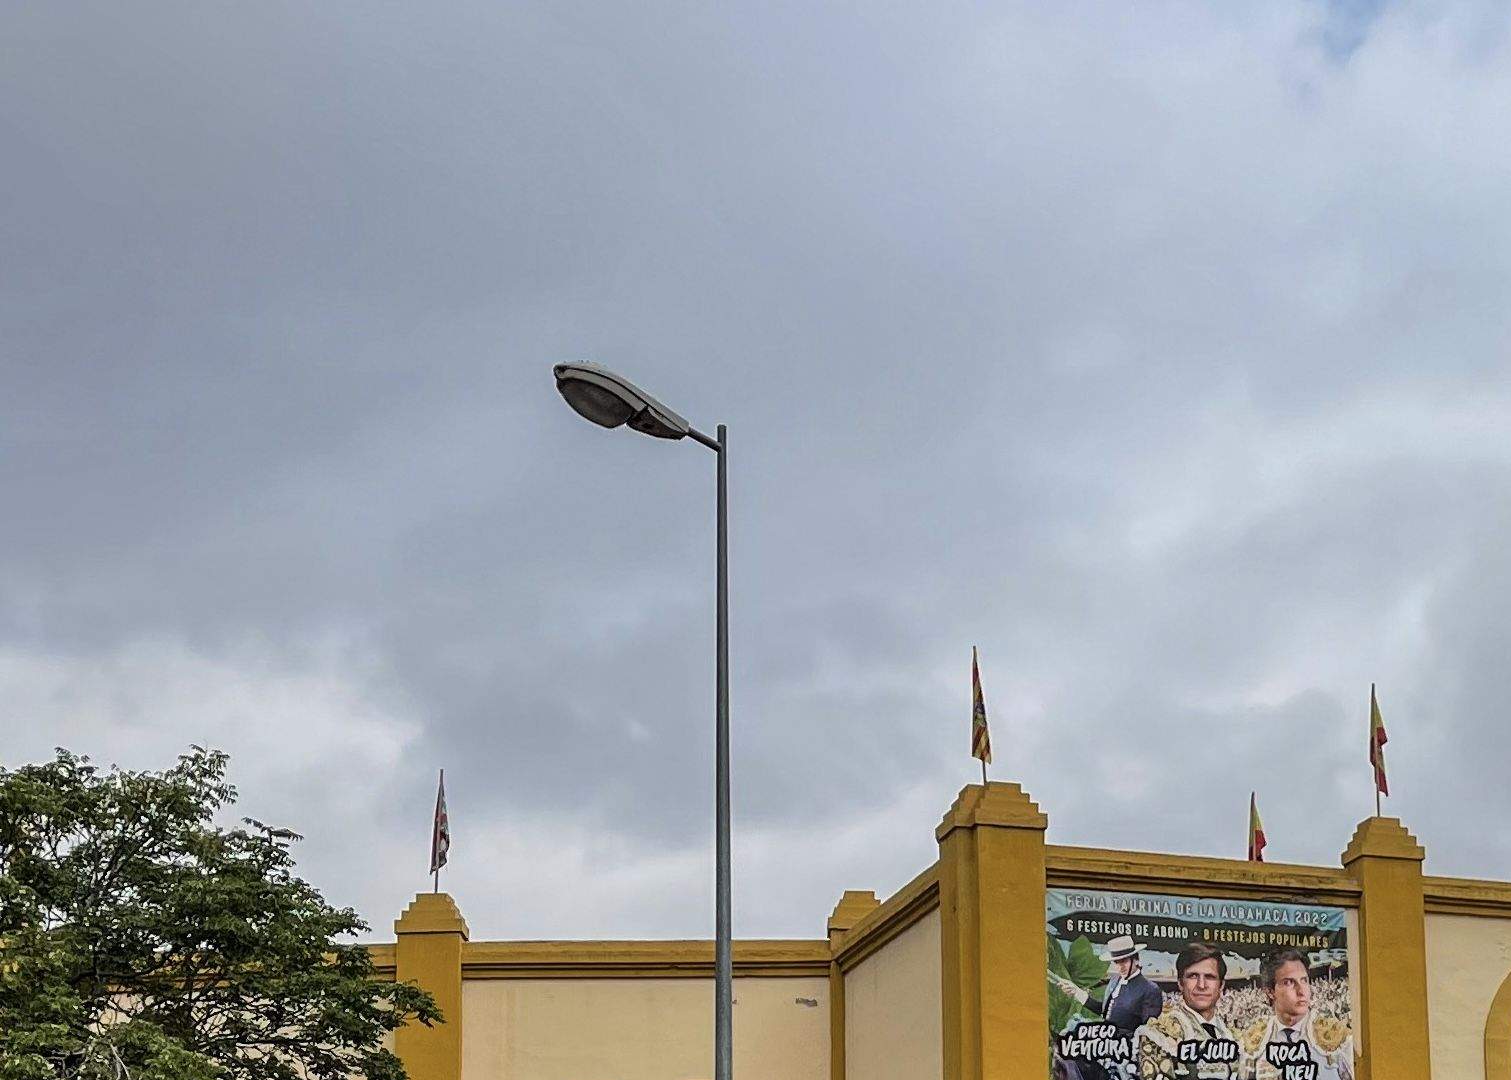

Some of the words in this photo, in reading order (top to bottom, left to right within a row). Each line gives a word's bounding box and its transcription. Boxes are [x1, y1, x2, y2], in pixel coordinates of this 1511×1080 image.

[1067, 895, 1106, 910] FERIA
[1111, 896, 1170, 915] TAURINA
[1177, 903, 1192, 916] DE
[1199, 904, 1215, 918] LA
[1221, 905, 1289, 922] ALBAHACA
[1295, 911, 1329, 925] 2022
[1066, 919, 1074, 931] 6
[1078, 919, 1132, 935] FESTEJOS
[1135, 923, 1149, 937] DE
[1153, 925, 1189, 939] ABONO
[1203, 928, 1210, 940] 8
[1213, 928, 1266, 944] FESTEJOS
[1269, 932, 1329, 948] POPULARES
[1078, 1025, 1116, 1039] DIEGO
[1061, 1036, 1130, 1061] VENTURA
[1202, 1042, 1236, 1062] JULI
[1269, 1043, 1308, 1064] ROCA
